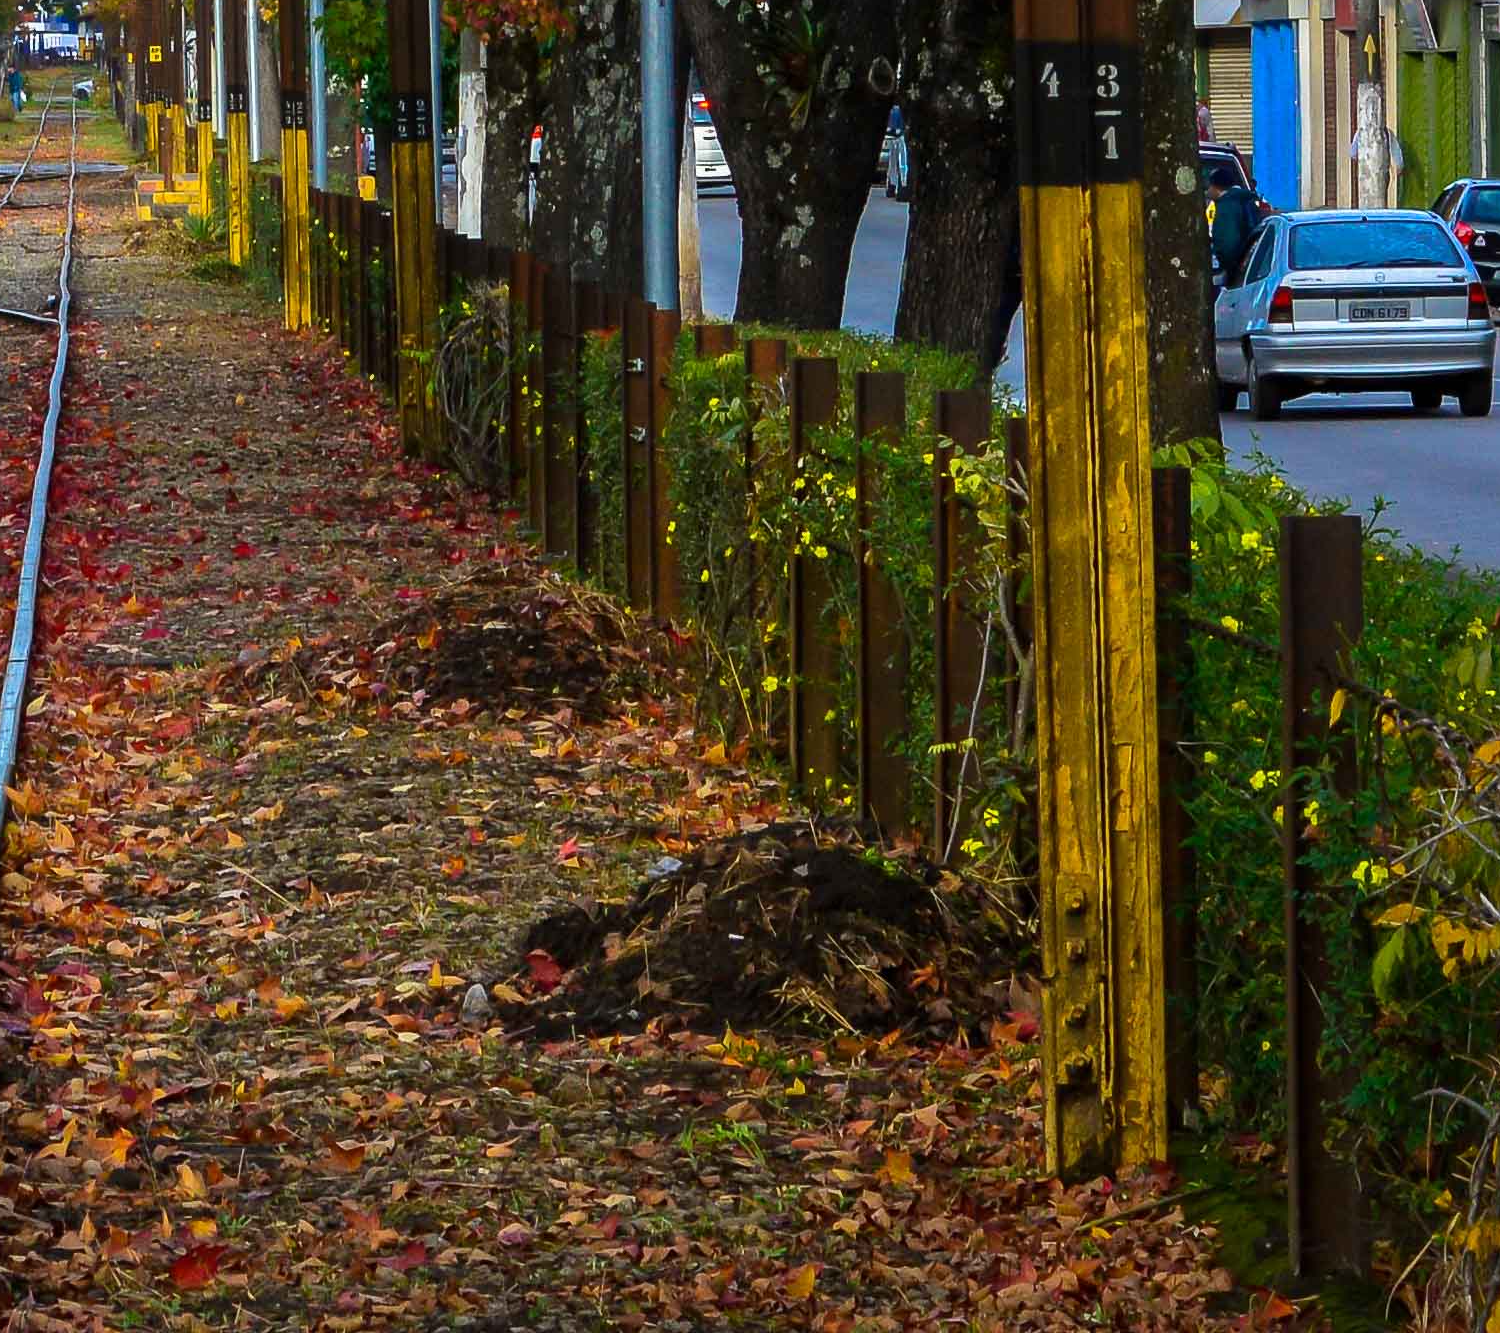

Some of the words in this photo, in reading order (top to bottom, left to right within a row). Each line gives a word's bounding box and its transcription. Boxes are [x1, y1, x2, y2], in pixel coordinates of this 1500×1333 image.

[1040, 62, 1060, 98] 4
[1096, 64, 1120, 98] 3
[1102, 125, 1119, 159] 1
